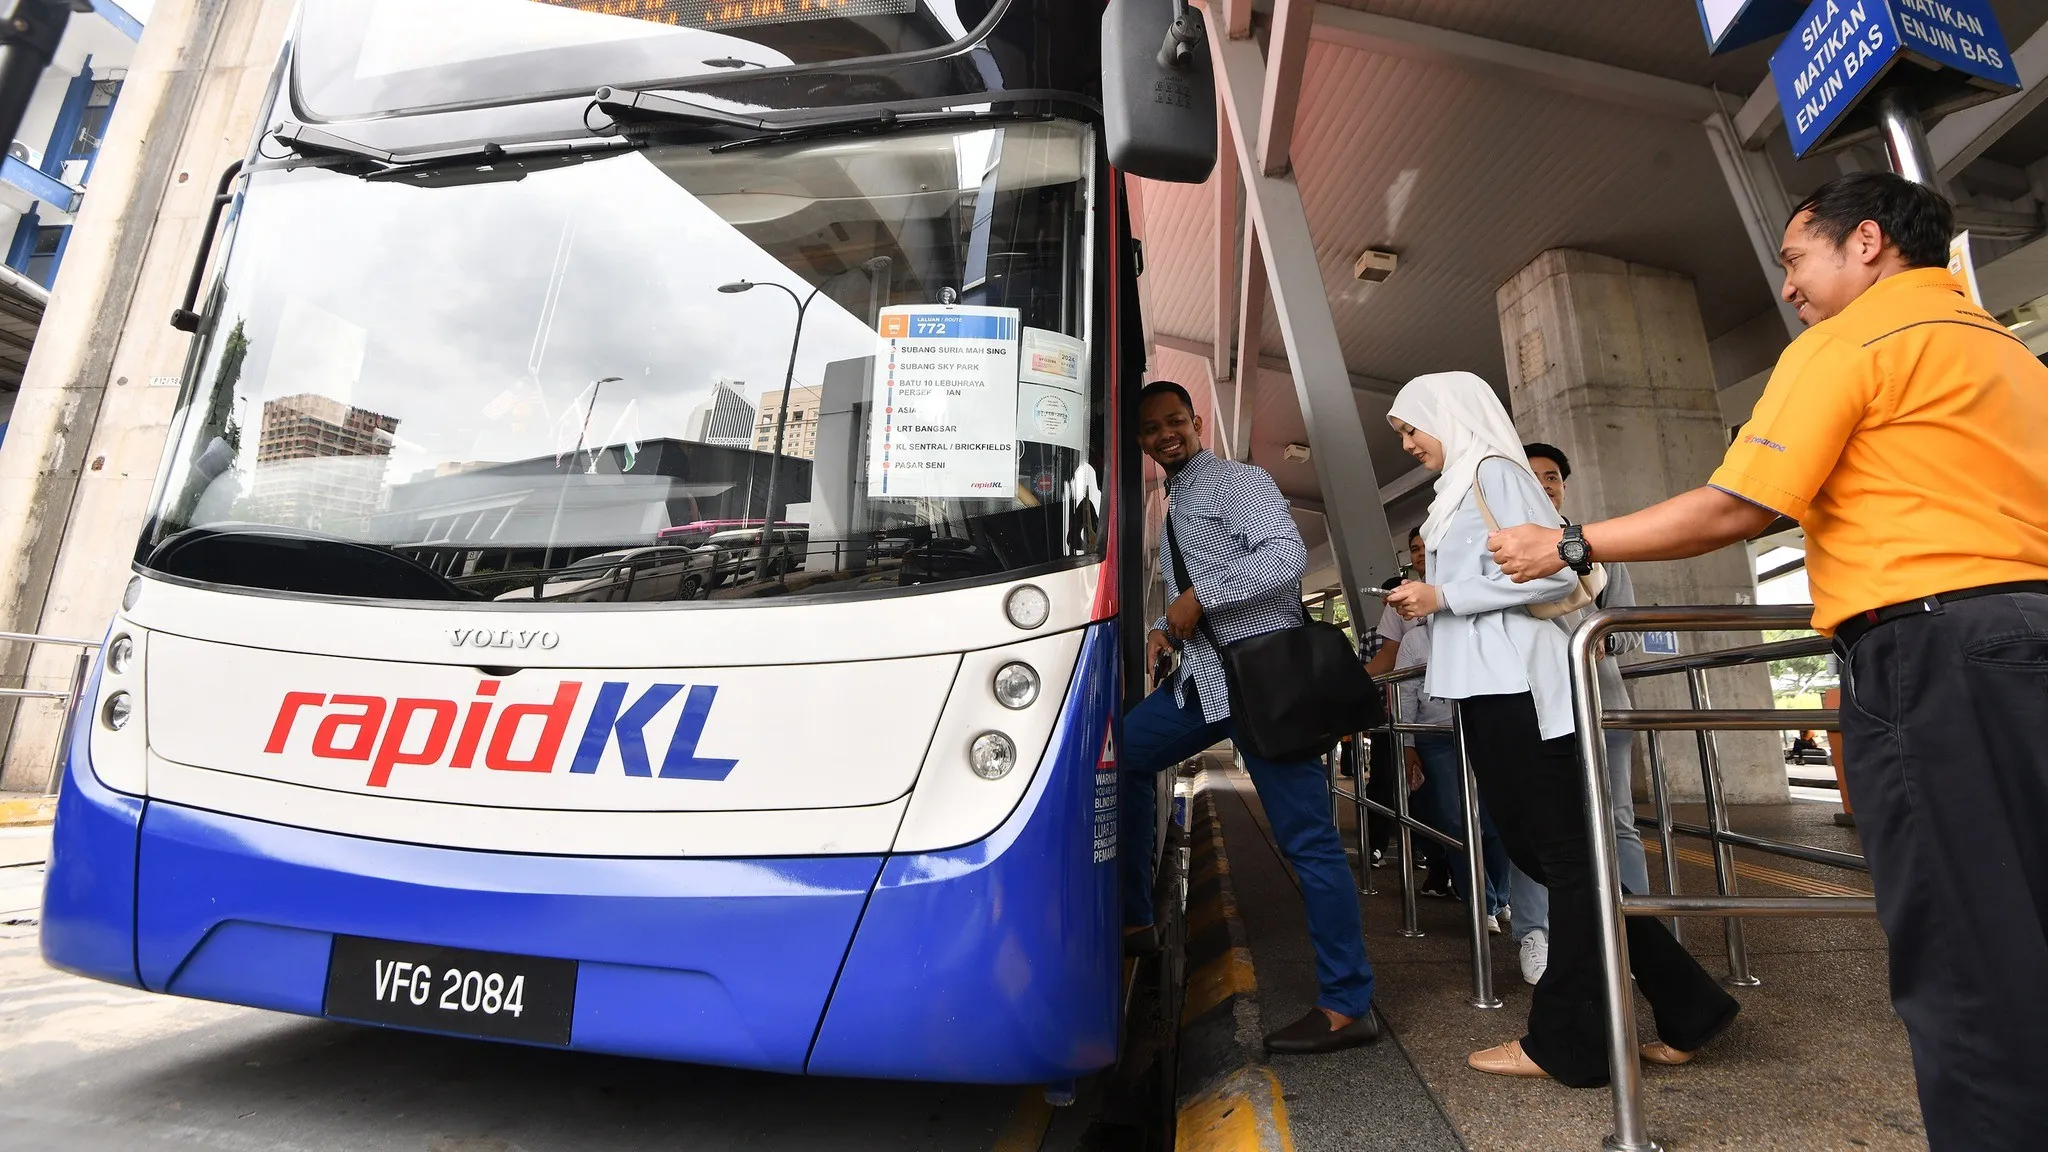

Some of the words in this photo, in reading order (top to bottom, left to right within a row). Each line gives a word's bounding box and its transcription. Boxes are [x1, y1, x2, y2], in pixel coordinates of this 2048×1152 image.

[1801, 0, 1840, 51] SILA
[1902, 0, 1985, 37] MATIKAN
[1793, 2, 1867, 100] MATIKAN
[1902, 12, 1958, 55] ENJIN
[1960, 38, 2004, 70] BAS
[1796, 68, 1844, 135] ENJIN
[1843, 24, 1883, 80] BAS
[917, 323, 946, 334] 772
[901, 346, 936, 354] SUBANG
[897, 425, 913, 433] LRT
[909, 443, 948, 451] SENTRAL
[955, 443, 1011, 451] BRICKFIELDS
[971, 481, 1003, 489] rapidKL
[447, 627, 560, 650] VOLVO
[264, 680, 739, 788] rapidKL
[375, 959, 432, 1006] VFG
[439, 968, 525, 1018] 2084
